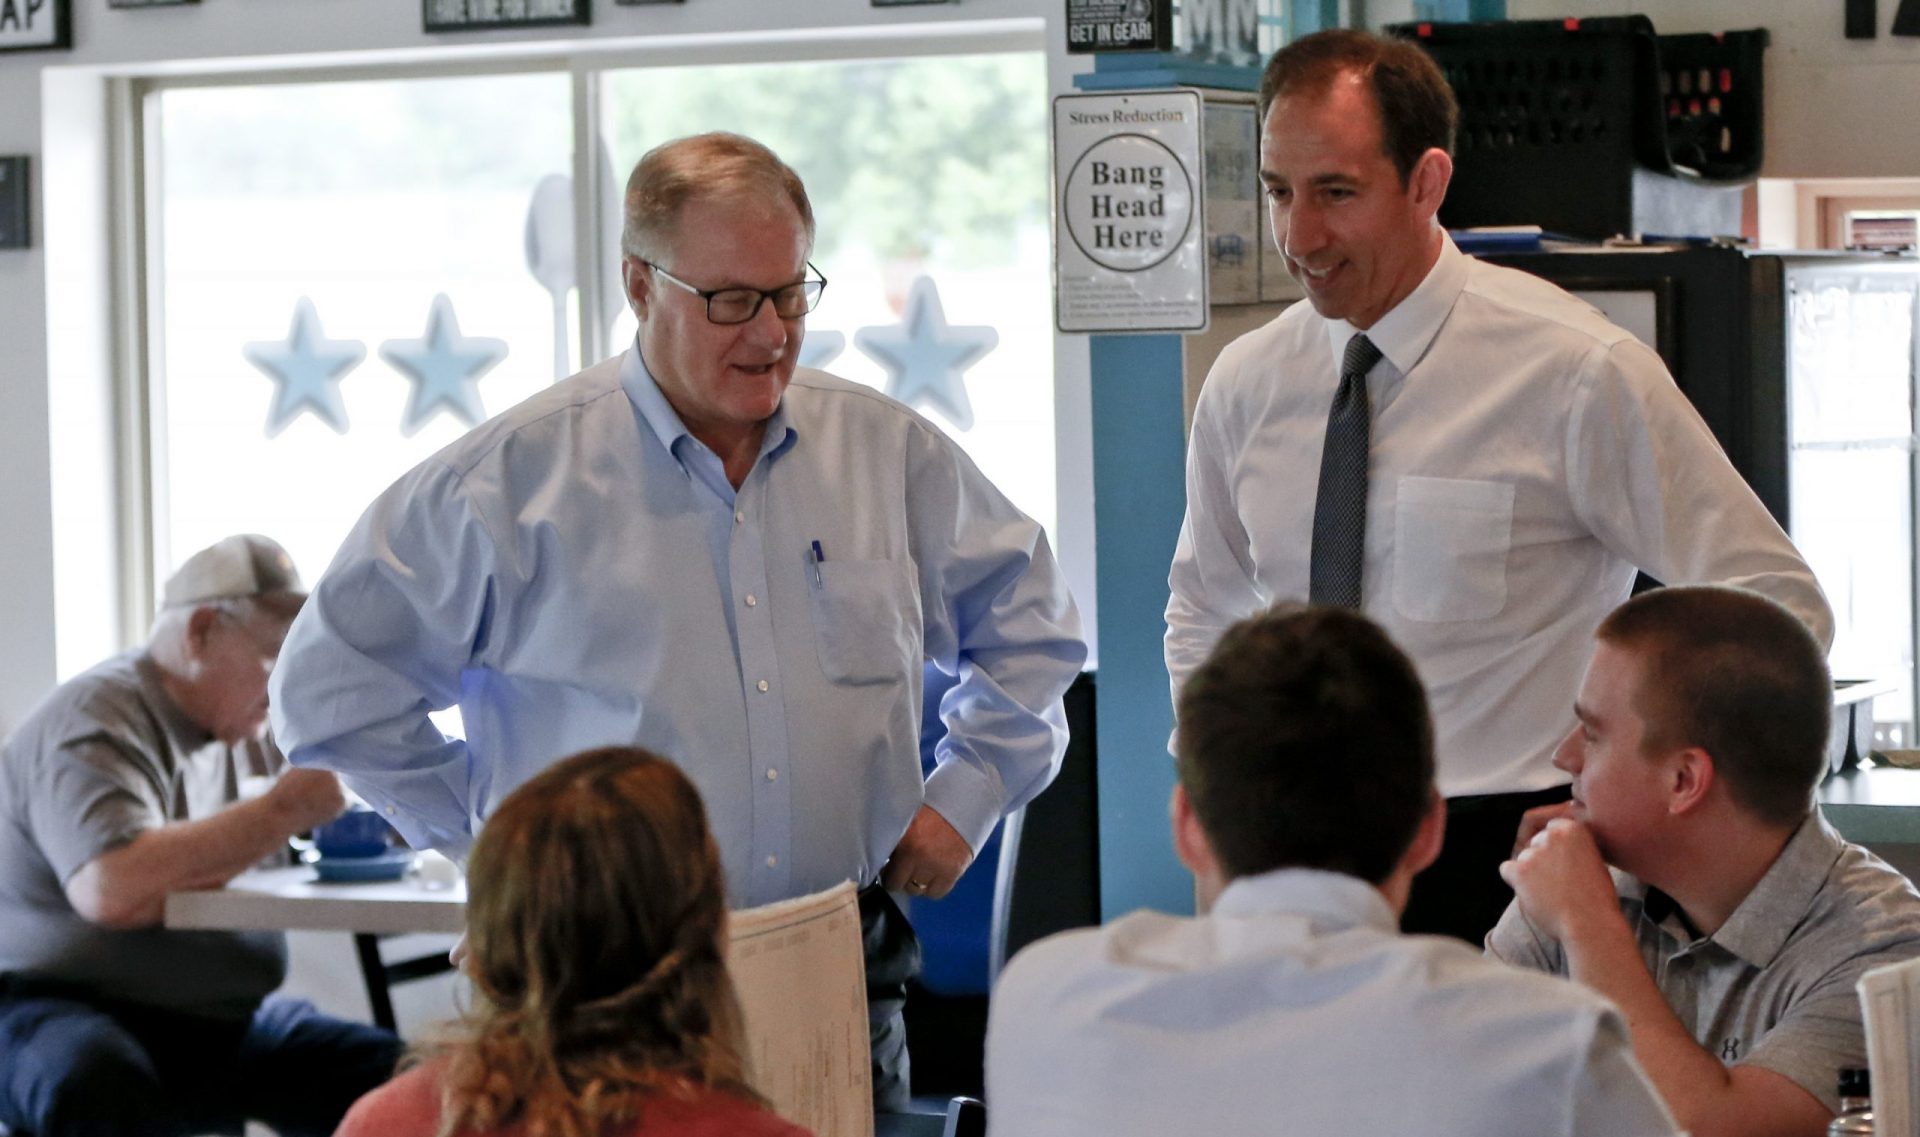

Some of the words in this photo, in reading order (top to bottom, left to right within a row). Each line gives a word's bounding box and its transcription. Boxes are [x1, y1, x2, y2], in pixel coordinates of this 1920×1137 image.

[1070, 24, 1095, 42] GET
[1097, 23, 1111, 41] IN
[1113, 21, 1153, 40] GEAR!
[1069, 111, 1110, 125] Stress
[1112, 108, 1184, 122] Reduction
[1091, 161, 1165, 191] Bang
[1091, 194, 1165, 219] Head
[1094, 224, 1163, 248] Here
